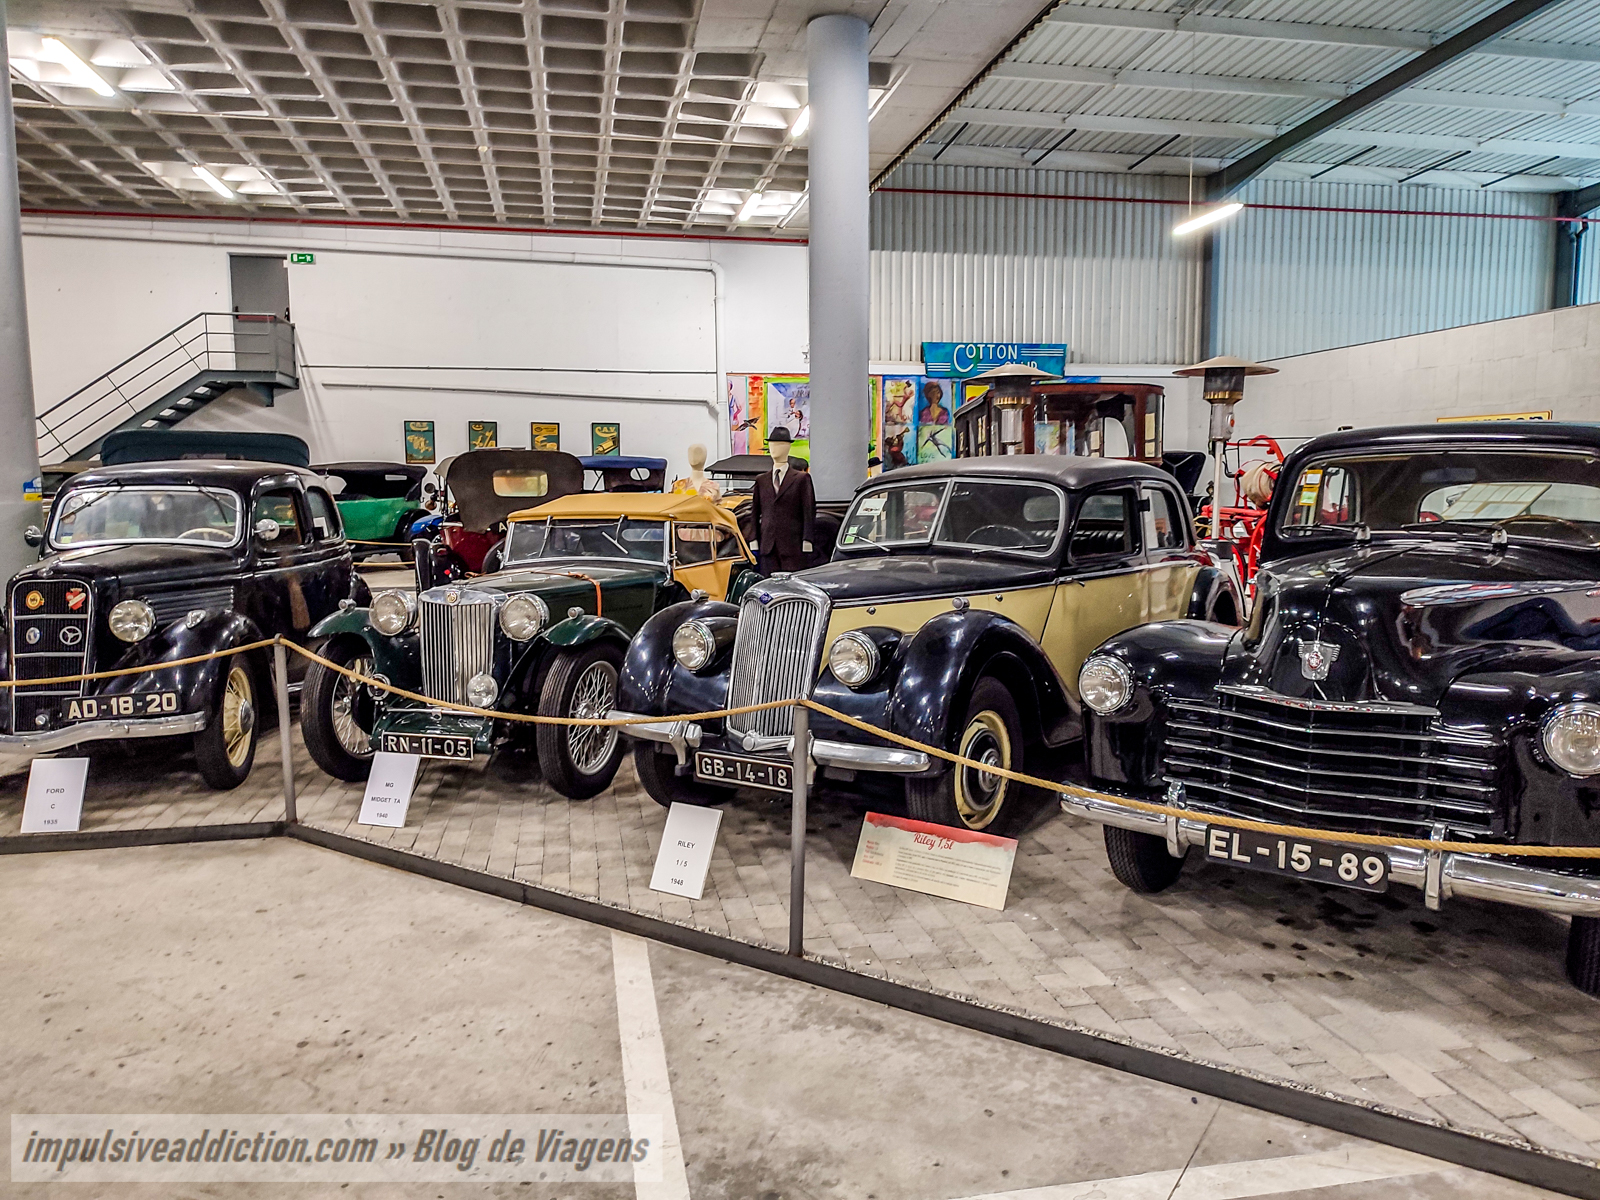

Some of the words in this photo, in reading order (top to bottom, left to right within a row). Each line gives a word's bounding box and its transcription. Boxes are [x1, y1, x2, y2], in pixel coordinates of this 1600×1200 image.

[953, 344, 1018, 373] COTTON
[68, 692, 177, 719] AD-18-20
[387, 735, 468, 757] RN-11-05
[701, 757, 788, 787] GB-14-18
[677, 840, 696, 849] RILEY
[913, 833, 936, 850] Riley
[1208, 829, 1385, 885] EL-15-89
[671, 878, 684, 886] 1948
